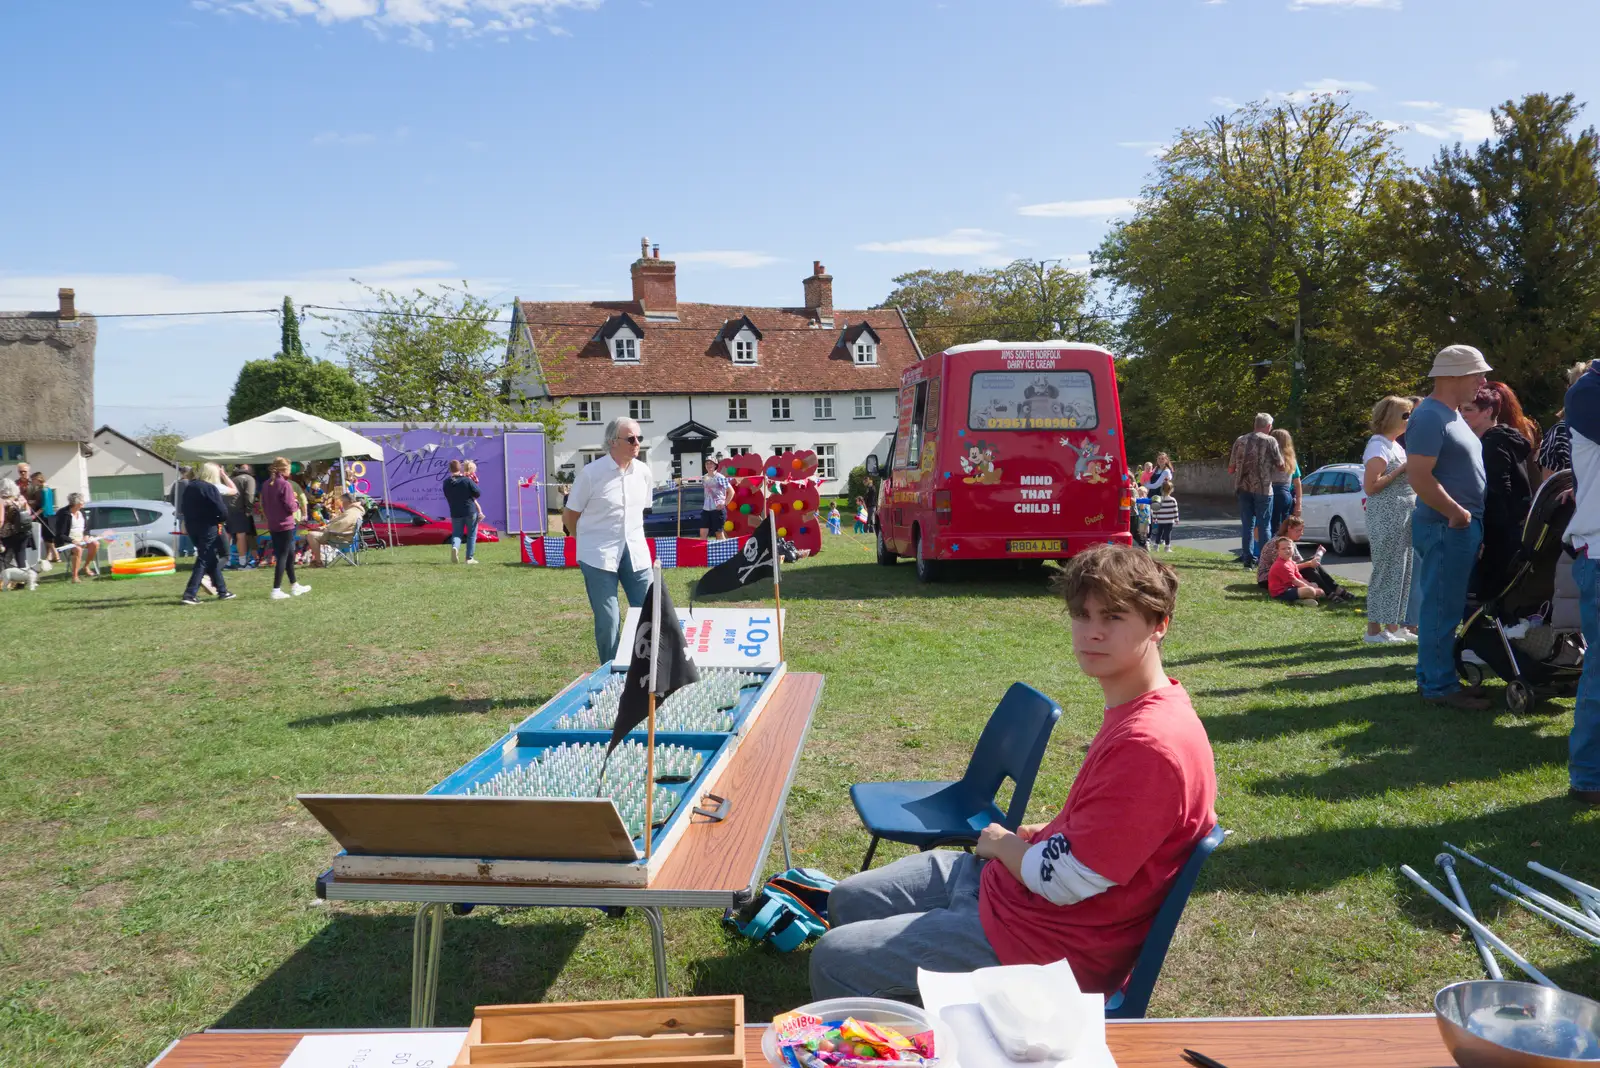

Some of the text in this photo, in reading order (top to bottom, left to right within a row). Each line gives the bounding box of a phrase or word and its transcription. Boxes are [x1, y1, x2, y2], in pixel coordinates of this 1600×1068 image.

[1001, 350, 1061, 359] JIMS SOUTH NORFOLK
[1007, 360, 1056, 369] DAIRY ICE CREAM
[1020, 475, 1053, 486] MIND
[1020, 489, 1053, 499] THAT
[1013, 503, 1061, 515] CHILD !!
[1012, 541, 1060, 551] R804 AJC
[737, 616, 771, 657] 10p
